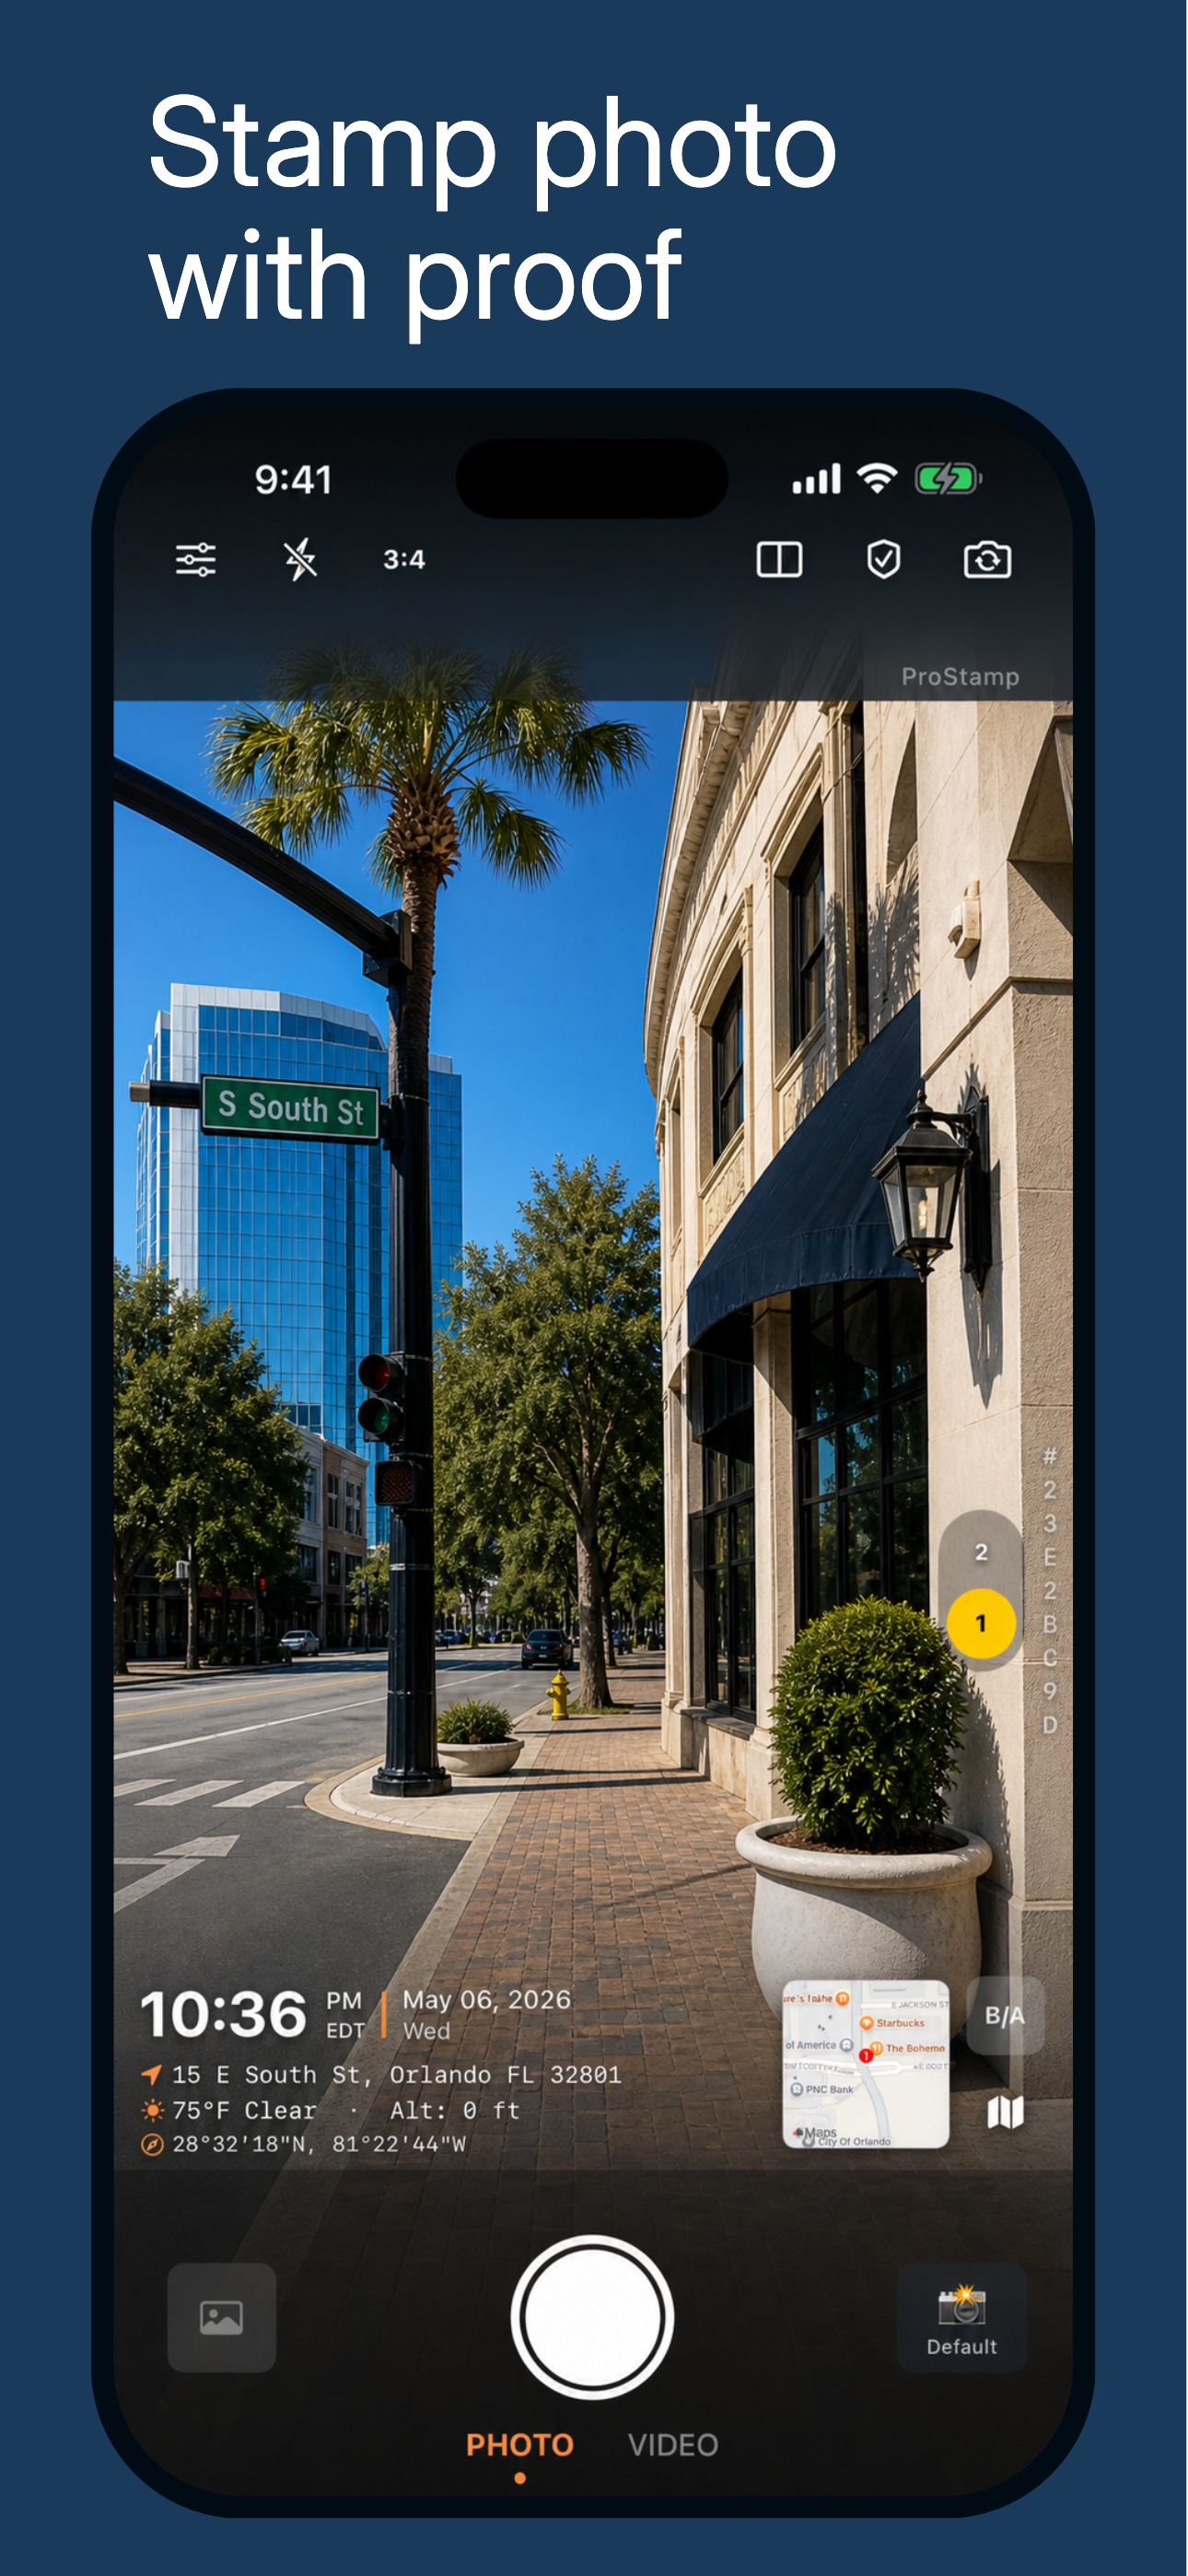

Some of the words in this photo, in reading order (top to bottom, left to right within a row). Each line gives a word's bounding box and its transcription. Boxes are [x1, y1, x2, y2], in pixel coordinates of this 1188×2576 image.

[254, 464, 332, 496] 9:41
[383, 548, 426, 570] 3:4
[218, 1090, 237, 1118] S
[249, 1093, 328, 1124] South
[337, 1099, 364, 1127] St
[974, 1542, 988, 1562] 2
[975, 1614, 986, 1633] 1
[877, 2019, 925, 2028] Starbucks
[985, 2006, 1026, 2030] B/A
[798, 2040, 836, 2050] America
[886, 2043, 904, 2053] The
[806, 2085, 828, 2094] PNC
[830, 2085, 854, 2094] Bank
[804, 2126, 837, 2138] Maps
[819, 2137, 837, 2149] City
[839, 2137, 851, 2147] Of
[853, 2137, 891, 2147] Orlando
[926, 2338, 998, 2357] Default
[466, 2431, 575, 2458] PHOTO
[627, 2432, 719, 2458] VIDEO
